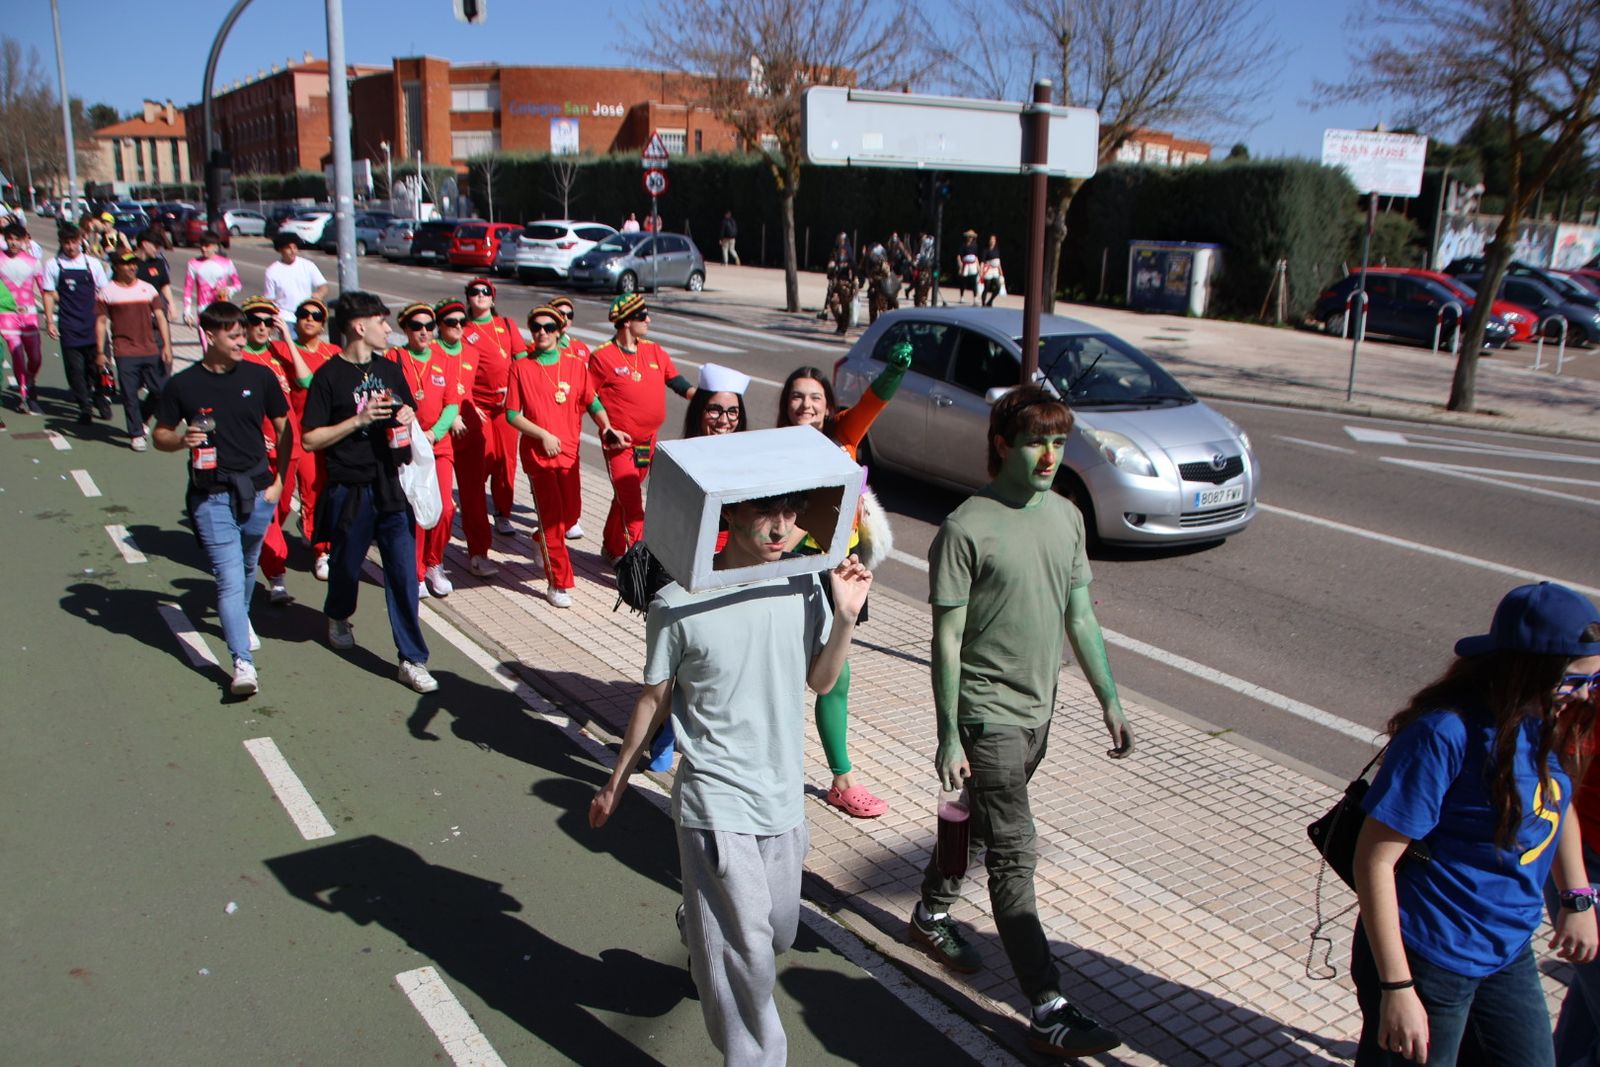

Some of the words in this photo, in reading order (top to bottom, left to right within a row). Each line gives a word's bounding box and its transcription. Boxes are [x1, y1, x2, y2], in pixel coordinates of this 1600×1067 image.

[564, 101, 589, 115] San
[592, 101, 625, 117] José
[1201, 491, 1224, 505] 8087
